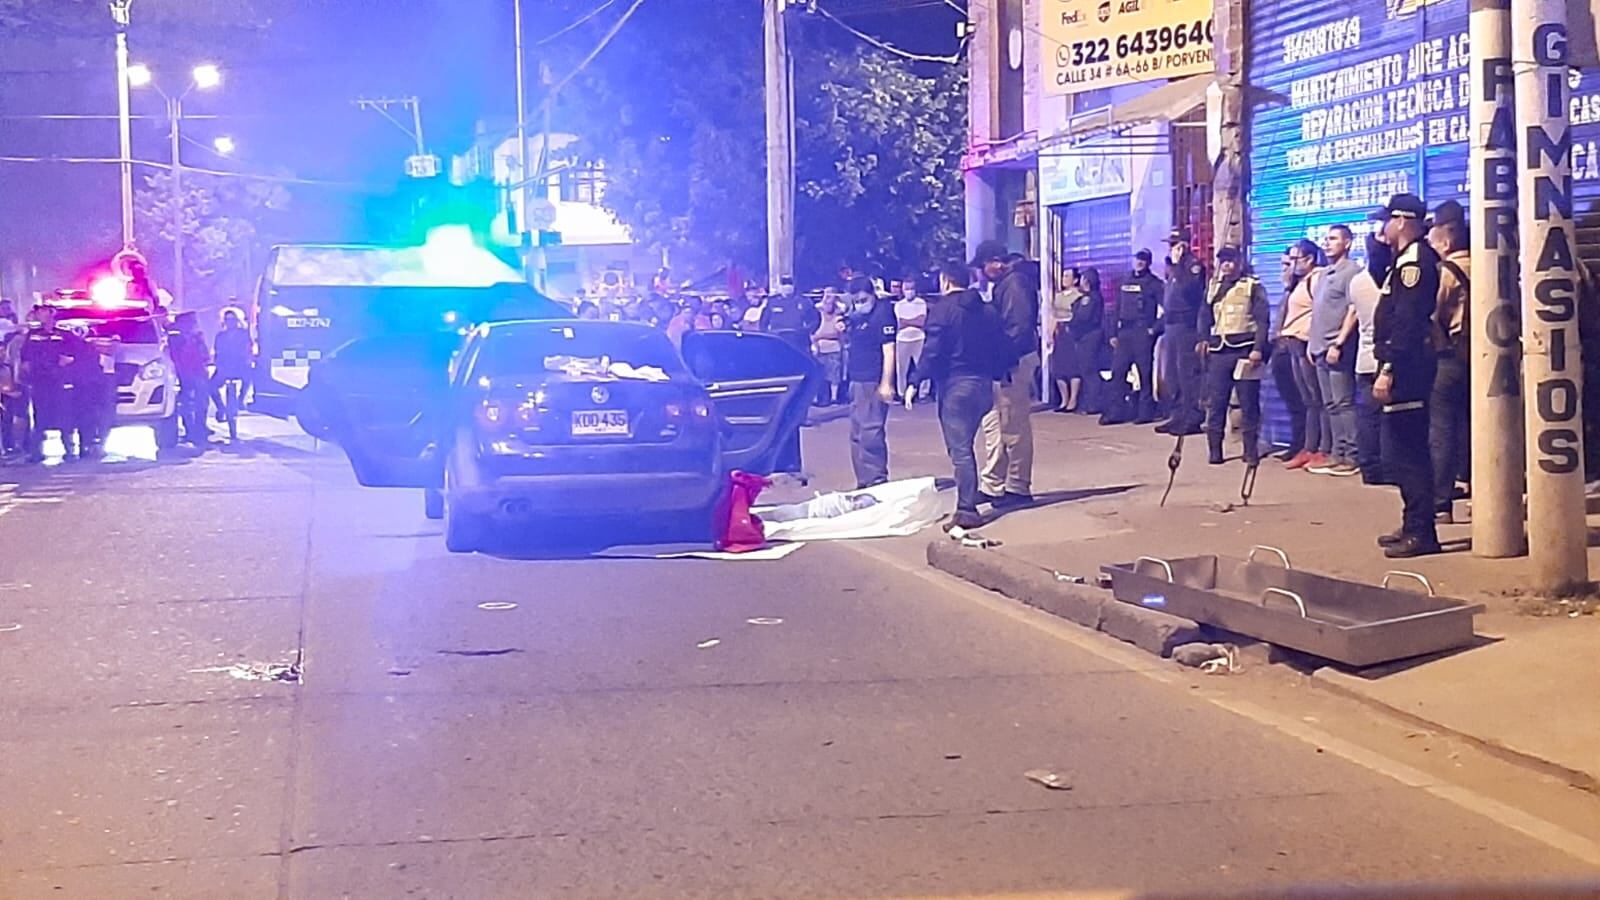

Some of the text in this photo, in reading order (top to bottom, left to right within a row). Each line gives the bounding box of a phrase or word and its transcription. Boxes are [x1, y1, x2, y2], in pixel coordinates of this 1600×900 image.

[1072, 38, 1109, 66] 322
[1407, 38, 1443, 81] AIRE
[1056, 69, 1086, 85] CALLE
[1090, 67, 1101, 80] 34
[1116, 60, 1149, 77] 6A-66
[1301, 92, 1384, 141] REPARACION
[1388, 76, 1455, 124] TECNICA
[1527, 23, 1578, 475] GIMNASIOS
[602, 412, 626, 427] 435
